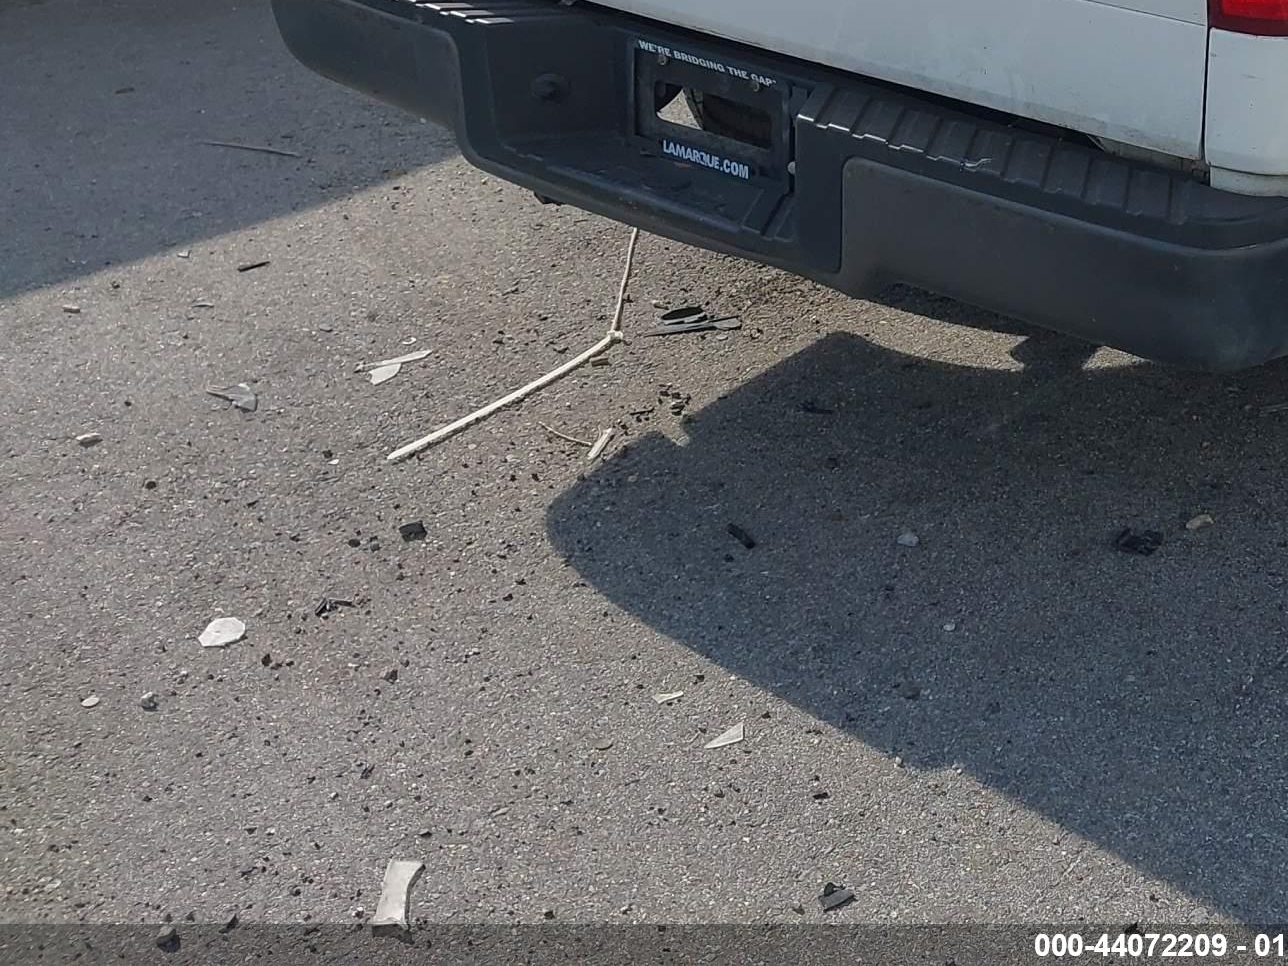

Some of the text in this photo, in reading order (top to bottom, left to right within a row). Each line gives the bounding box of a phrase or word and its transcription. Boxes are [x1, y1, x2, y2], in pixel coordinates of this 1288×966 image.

[638, 40, 671, 57] WE'RE
[673, 50, 726, 73] BRIDGING
[726, 65, 750, 80] THE
[663, 139, 749, 179] LAMARQUE.COM
